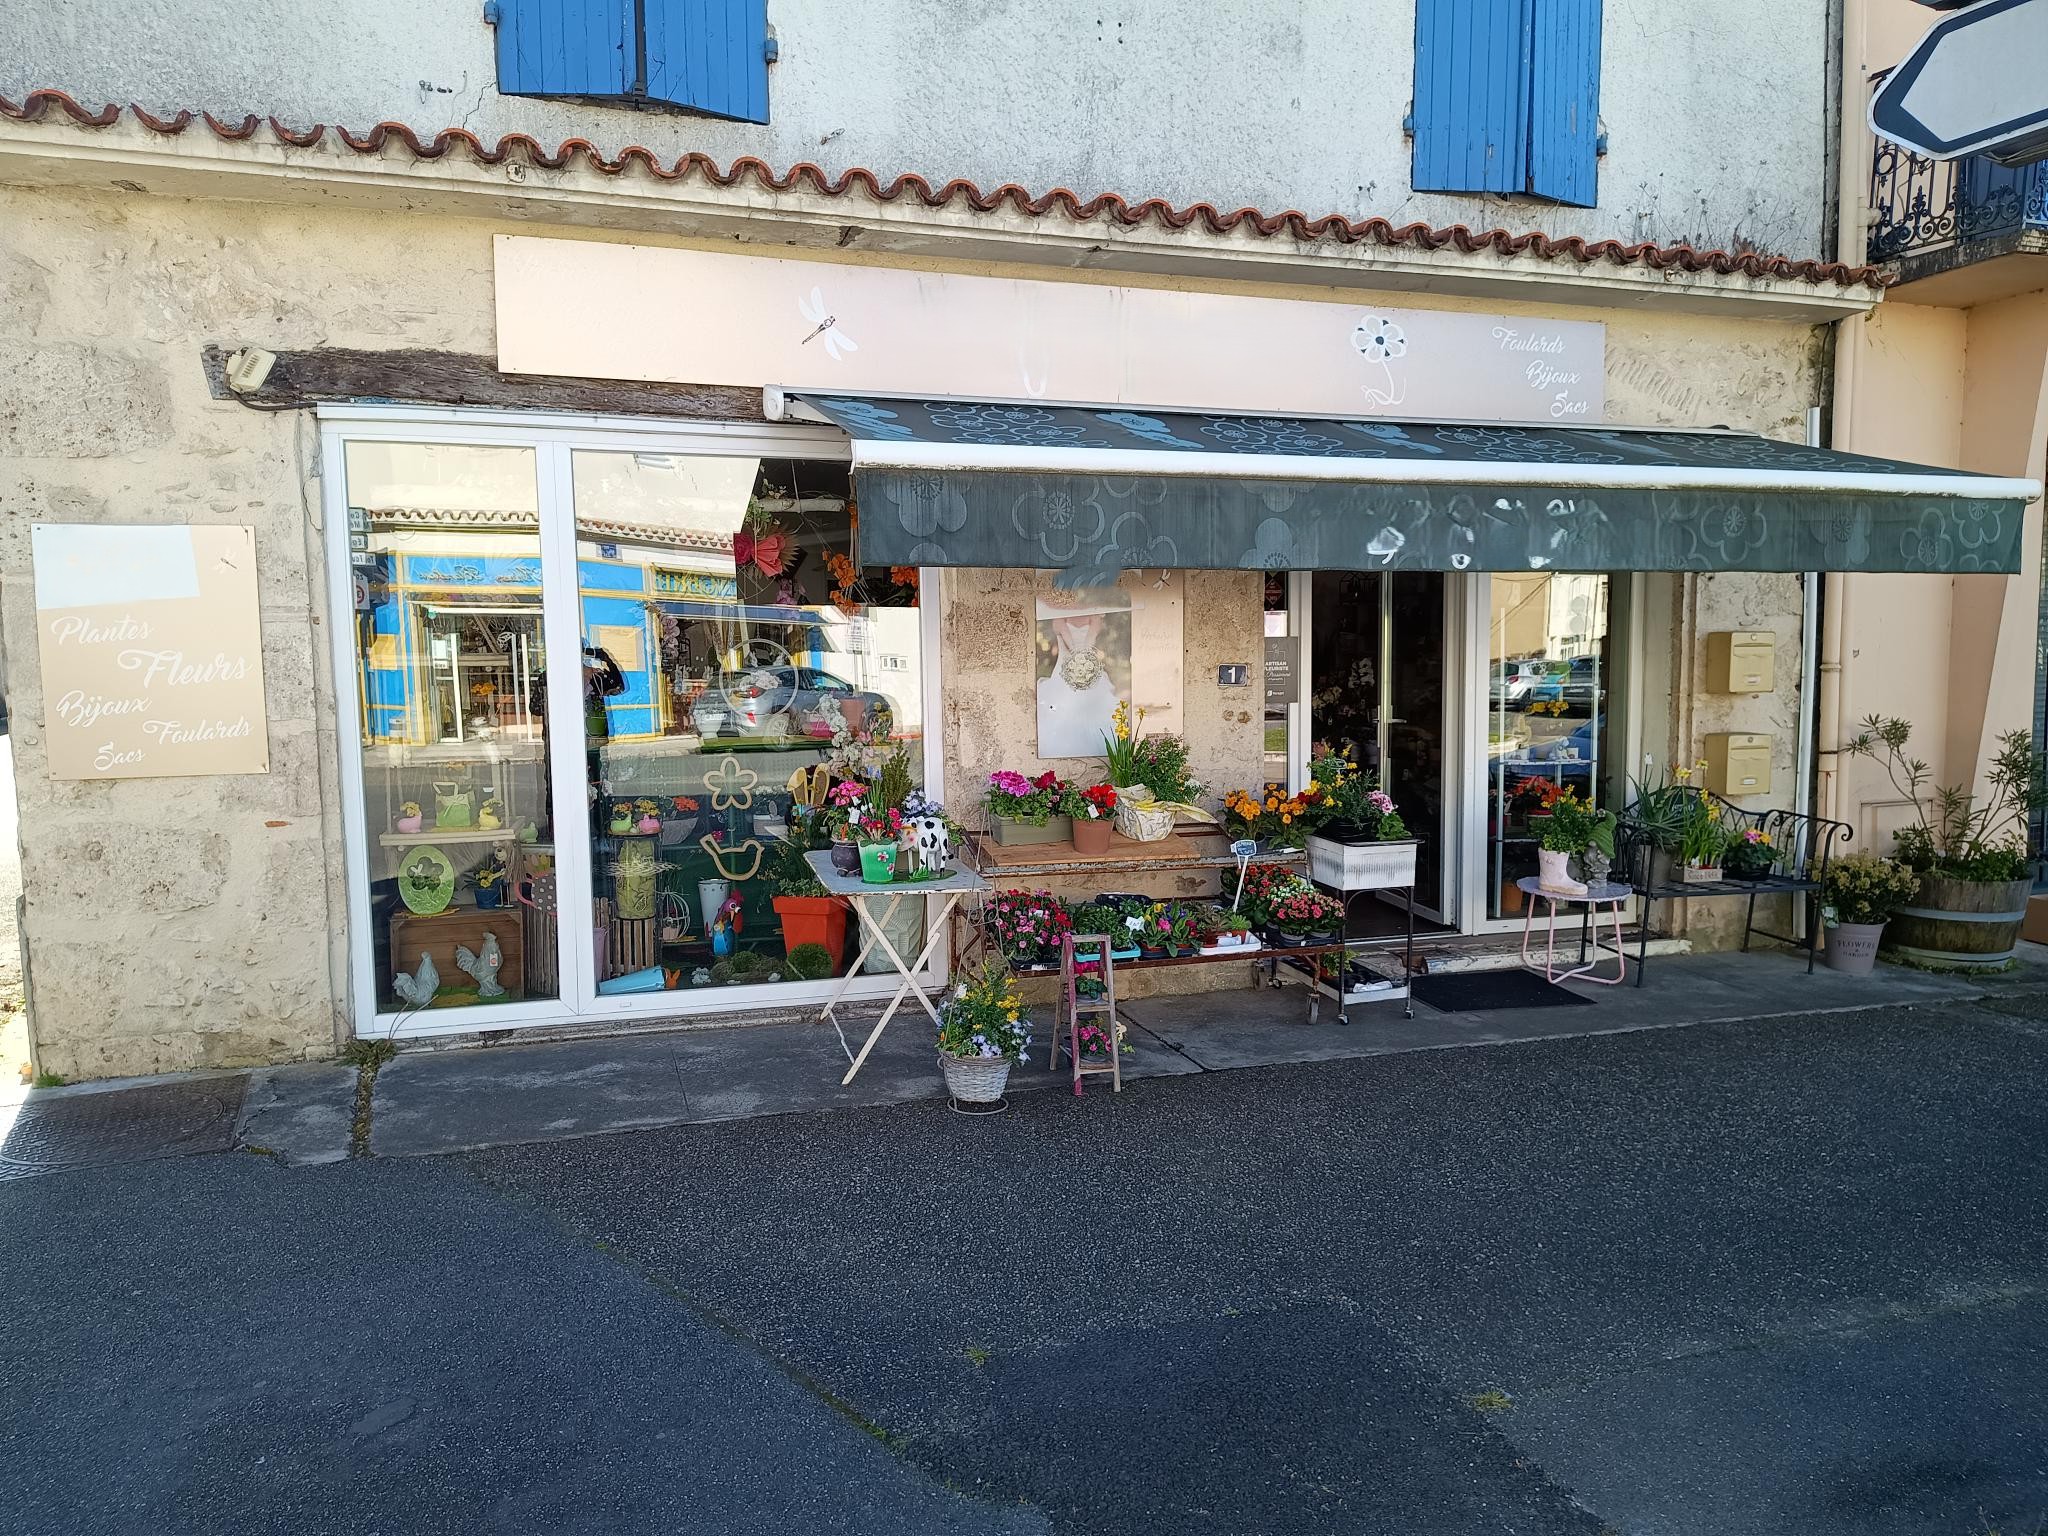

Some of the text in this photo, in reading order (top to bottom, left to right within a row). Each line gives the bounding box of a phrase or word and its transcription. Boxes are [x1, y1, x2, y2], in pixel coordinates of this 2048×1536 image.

[1491, 326, 1567, 354] Foulards
[1525, 359, 1582, 390] Bijoux
[1550, 390, 1590, 418] Sacs
[50, 614, 153, 645] Plantes
[116, 649, 253, 689] Fleurs
[1228, 666, 1236, 683] 1
[55, 689, 153, 728] Bijoux
[142, 715, 254, 745] Foulards
[93, 741, 145, 771] Sacs
